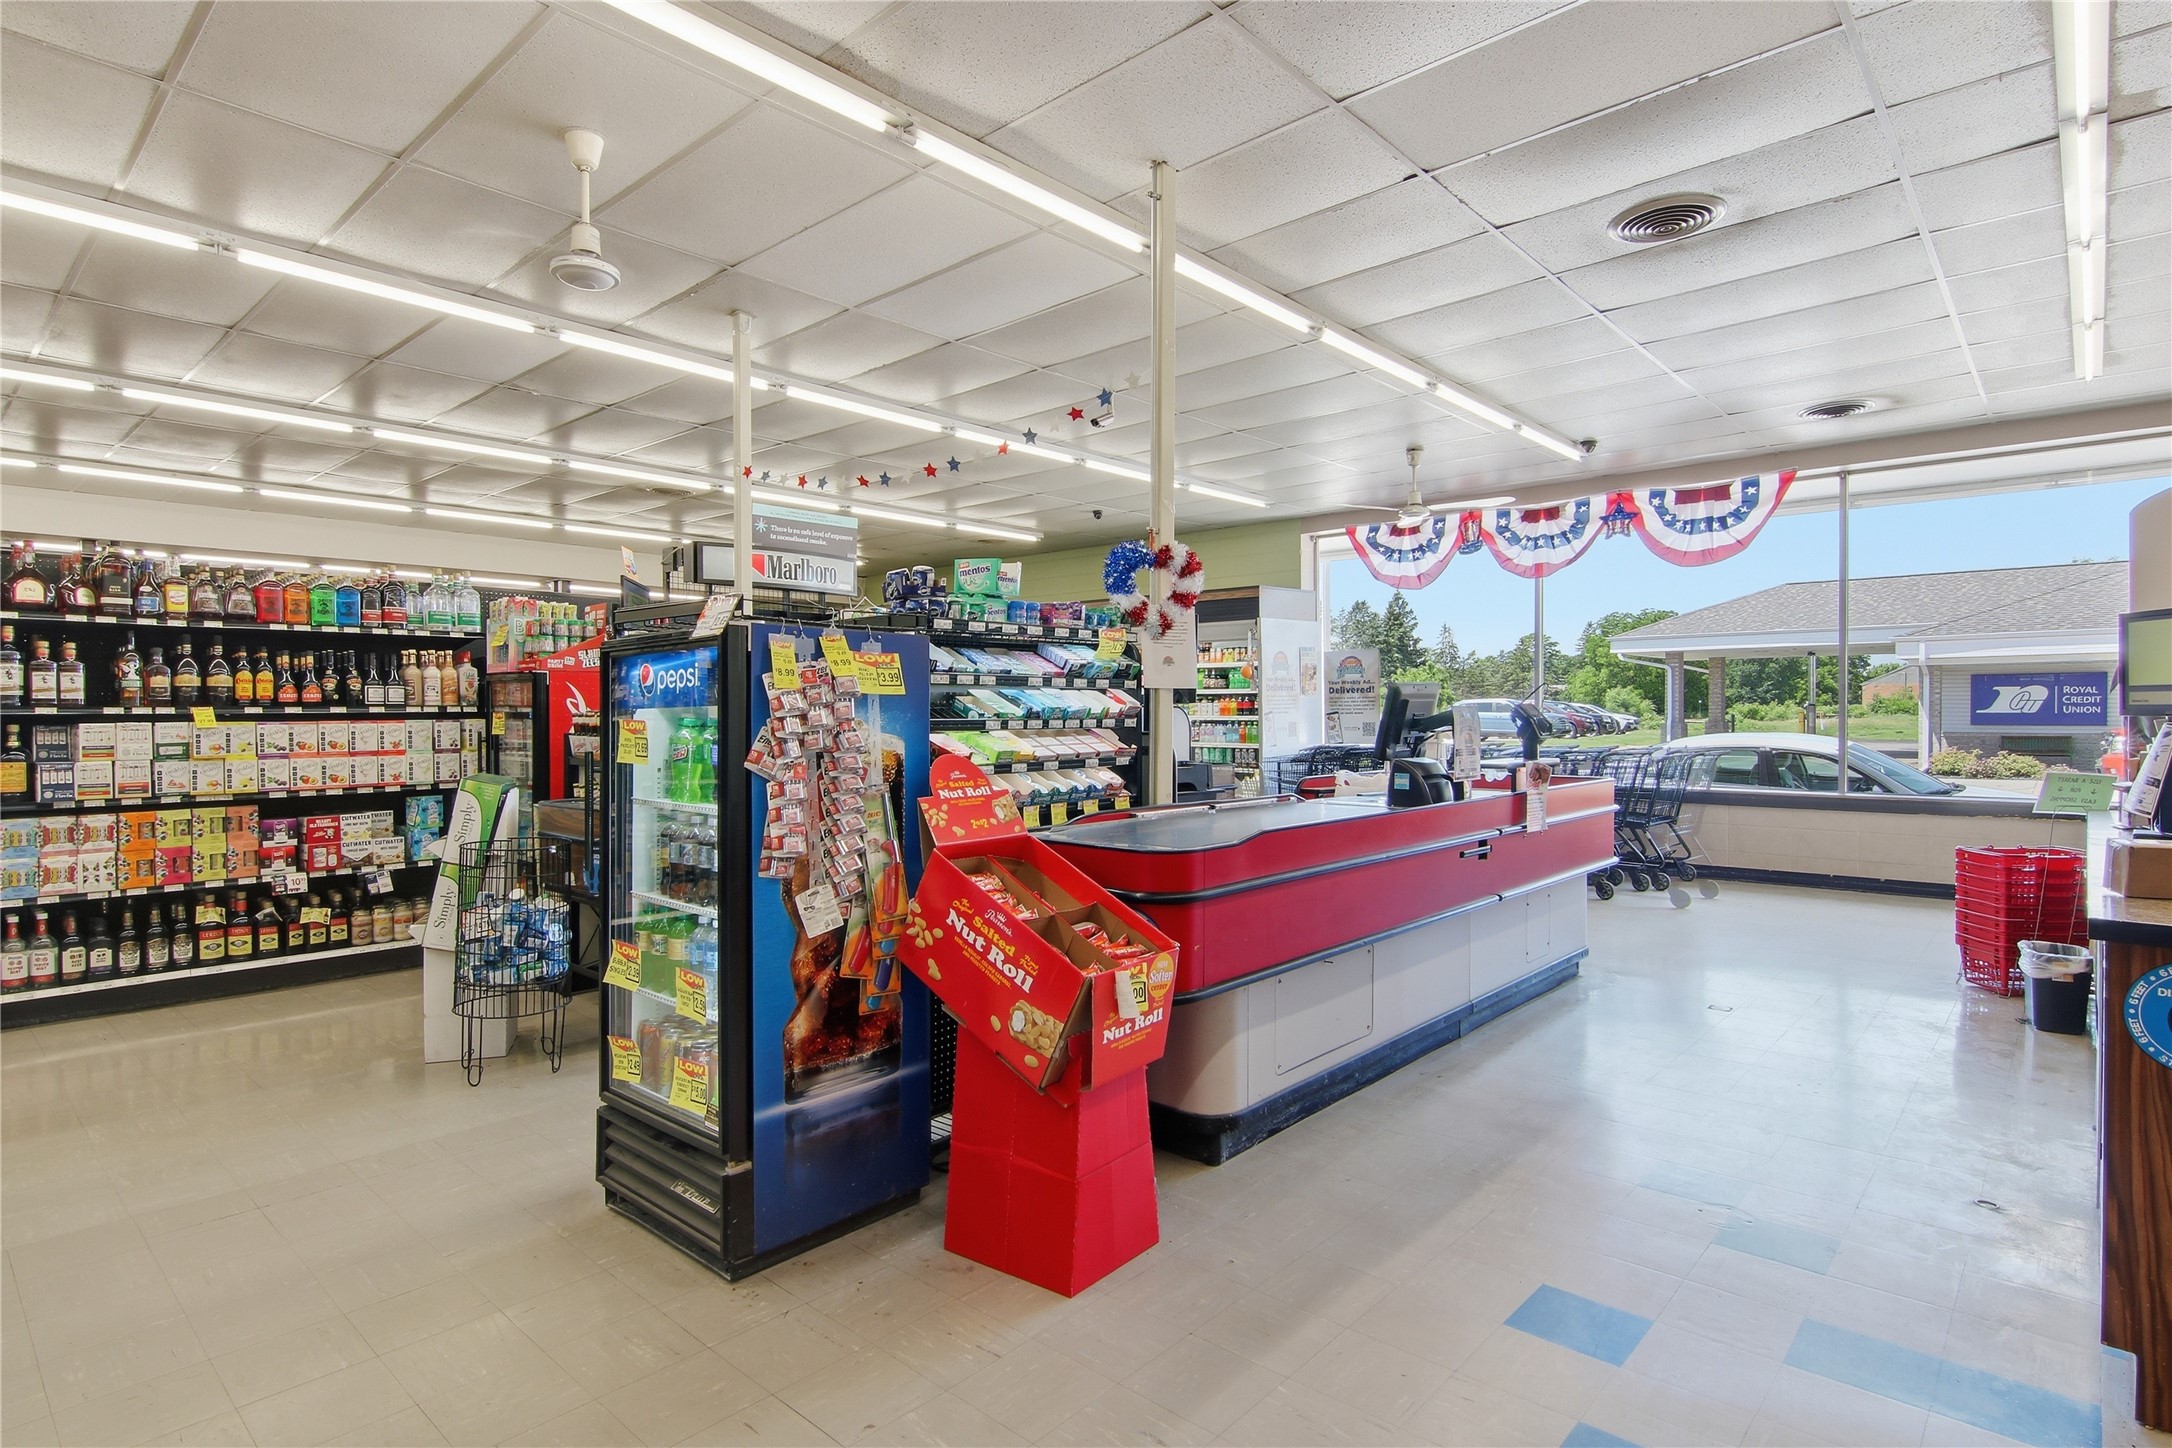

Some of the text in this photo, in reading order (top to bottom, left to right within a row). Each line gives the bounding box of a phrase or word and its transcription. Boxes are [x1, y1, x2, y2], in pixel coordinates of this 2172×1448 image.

[767, 554, 837, 585] Marlboro
[959, 565, 991, 577] mentos
[657, 662, 699, 695] pepsi
[1328, 685, 1375, 695] Delivered!
[2063, 685, 2098, 694] ROYAL
[2062, 695, 2102, 704] CREDIT
[2063, 706, 2101, 714] UNION
[948, 780, 975, 788] Salted
[937, 785, 992, 799] Nut Roll
[341, 813, 370, 822] CUTWATER
[454, 801, 476, 843] Simply
[342, 840, 371, 848] CUTWATER
[375, 837, 403, 846] CUTWATER
[434, 884, 457, 929] Simply
[972, 916, 1016, 957] Salted
[617, 943, 638, 958] LOW
[945, 907, 1034, 994] Nut Roll
[681, 970, 704, 987] LOW
[1149, 969, 1173, 984] Softer
[2130, 980, 2149, 998] FEET
[1102, 1021, 1132, 1044] Nut
[1134, 1007, 1164, 1031] Roll
[2128, 1017, 2144, 1037] FEET
[612, 1037, 634, 1048] LOW
[679, 1059, 704, 1075] LOW
